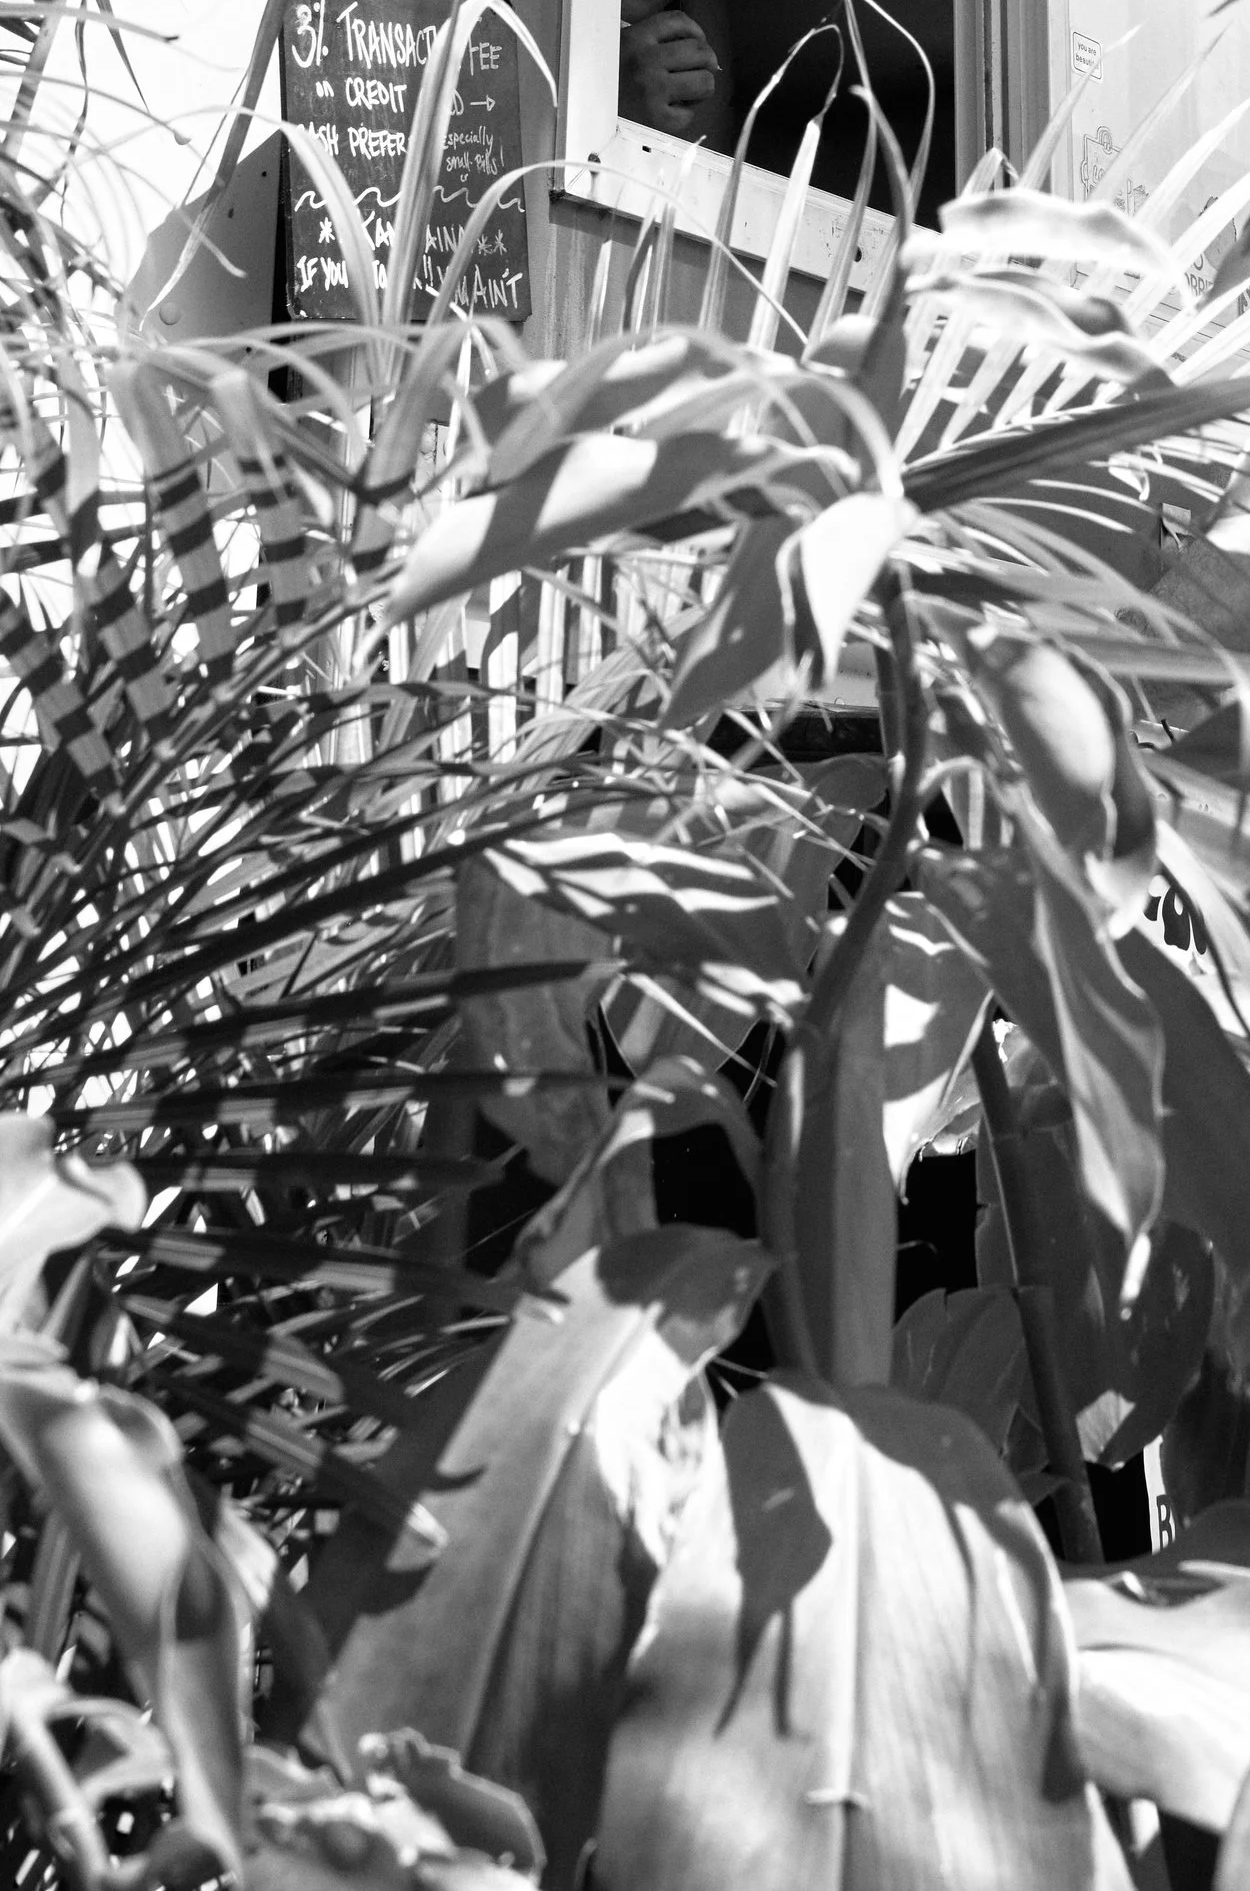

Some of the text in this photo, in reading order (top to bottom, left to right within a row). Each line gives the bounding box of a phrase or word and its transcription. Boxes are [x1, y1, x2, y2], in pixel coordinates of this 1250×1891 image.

[336, 1, 437, 69] TRANSACT
[468, 16, 502, 76] FEE
[1077, 41, 1097, 56] you are
[345, 77, 408, 113] CREDIT
[297, 121, 407, 160] ASH PREFER
[297, 255, 318, 292] IF
[320, 257, 348, 291] YOU
[473, 263, 523, 309] AIN'T
